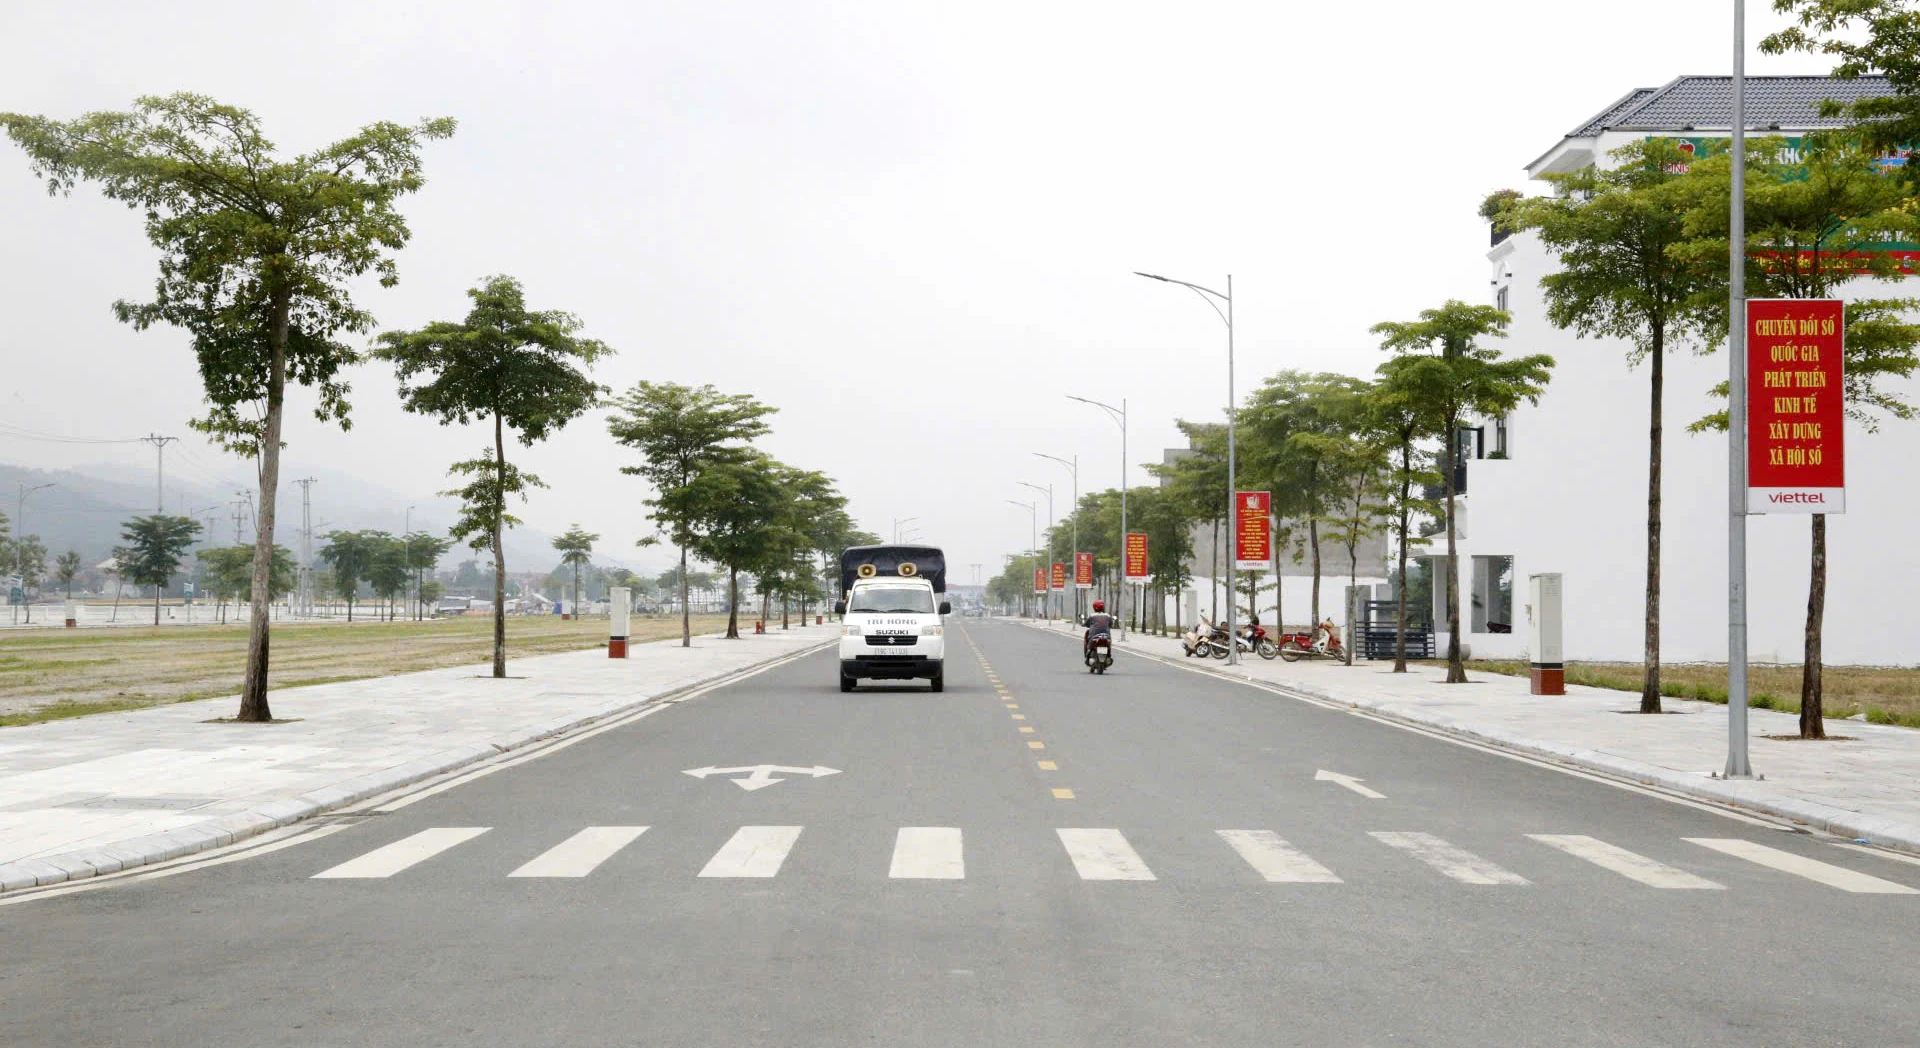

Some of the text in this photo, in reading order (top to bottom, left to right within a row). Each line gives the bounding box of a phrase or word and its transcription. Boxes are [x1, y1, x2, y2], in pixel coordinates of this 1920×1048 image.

[1756, 313, 1796, 335] CHUYỂN
[1821, 314, 1835, 335] SỐ
[1771, 340, 1819, 362] QUỐC GIA
[1764, 365, 1826, 387] PHÁT TRIỂN
[1774, 392, 1818, 413] KINH TẾ
[1769, 420, 1822, 441] XÂY DỰNG
[1769, 444, 1822, 467] XÃ HỘI SỐ
[1768, 492, 1825, 503] viettel
